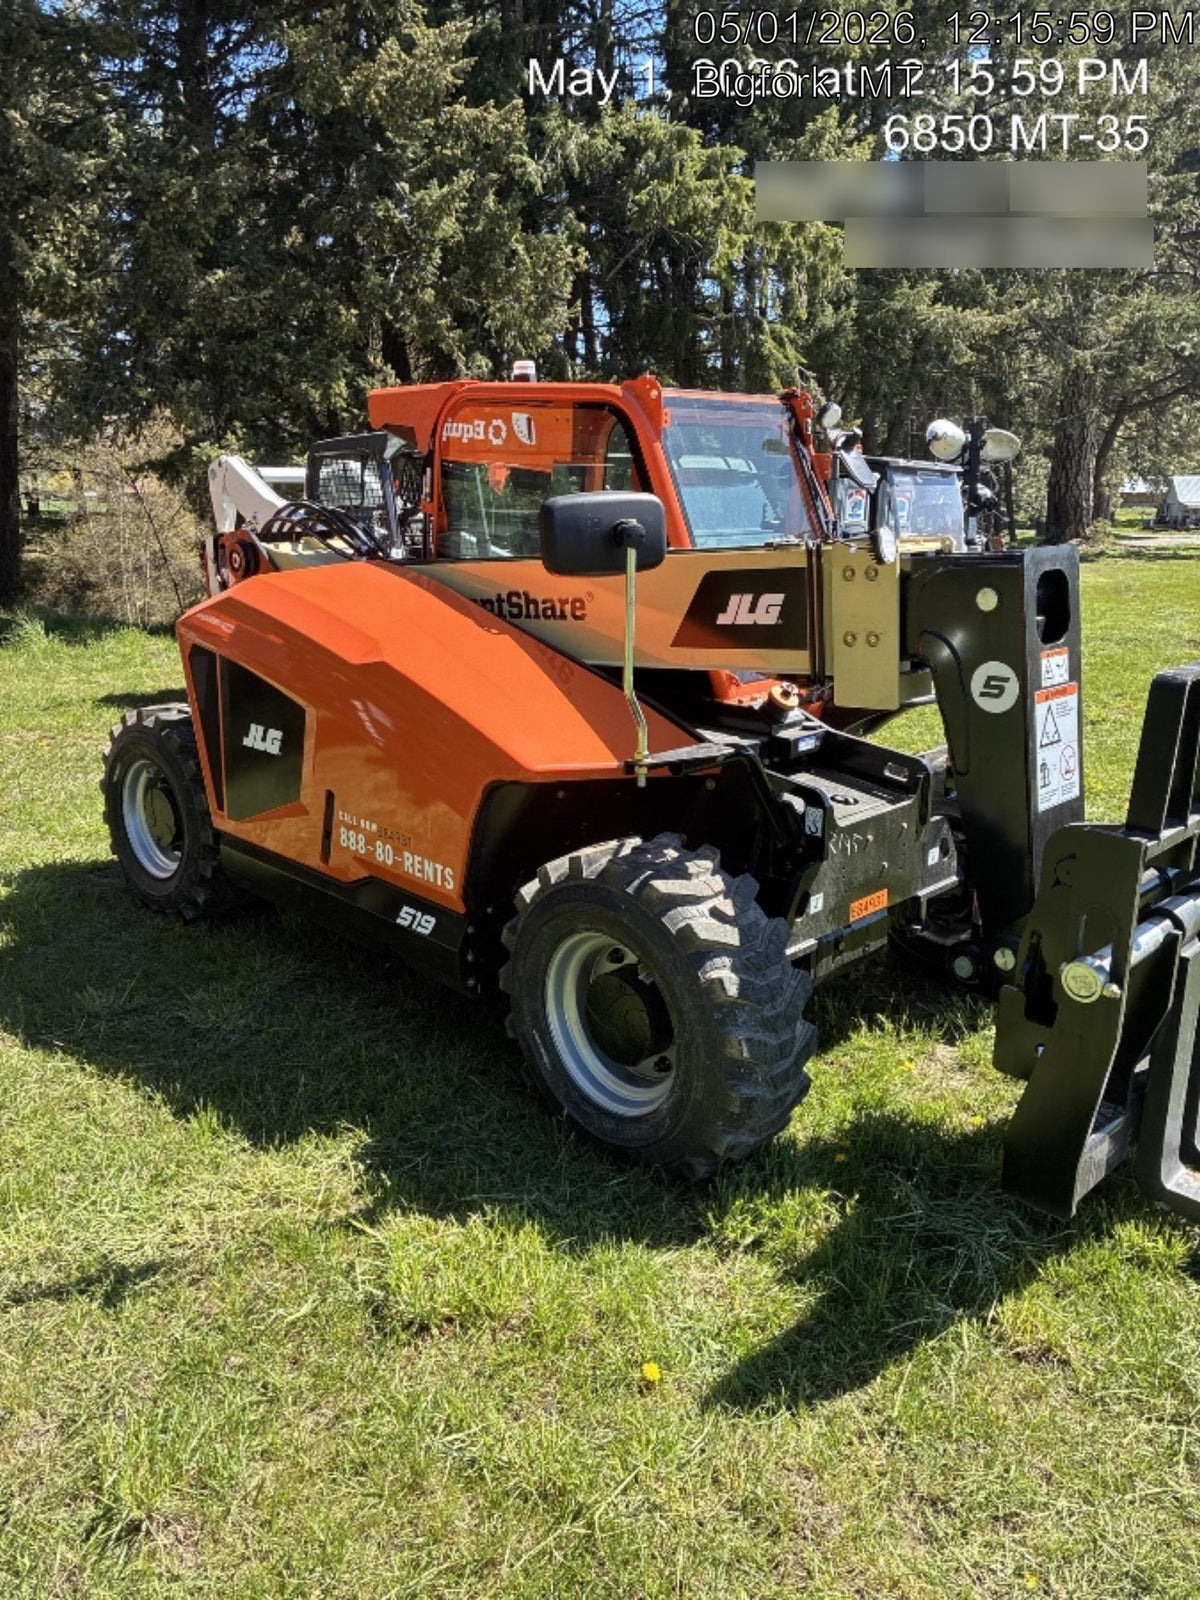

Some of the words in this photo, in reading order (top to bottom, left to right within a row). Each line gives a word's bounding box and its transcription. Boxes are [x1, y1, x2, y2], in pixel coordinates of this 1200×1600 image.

[715, 592, 785, 625] JLG
[242, 722, 283, 756] JLG
[340, 827, 455, 890] 888-80-RENTS
